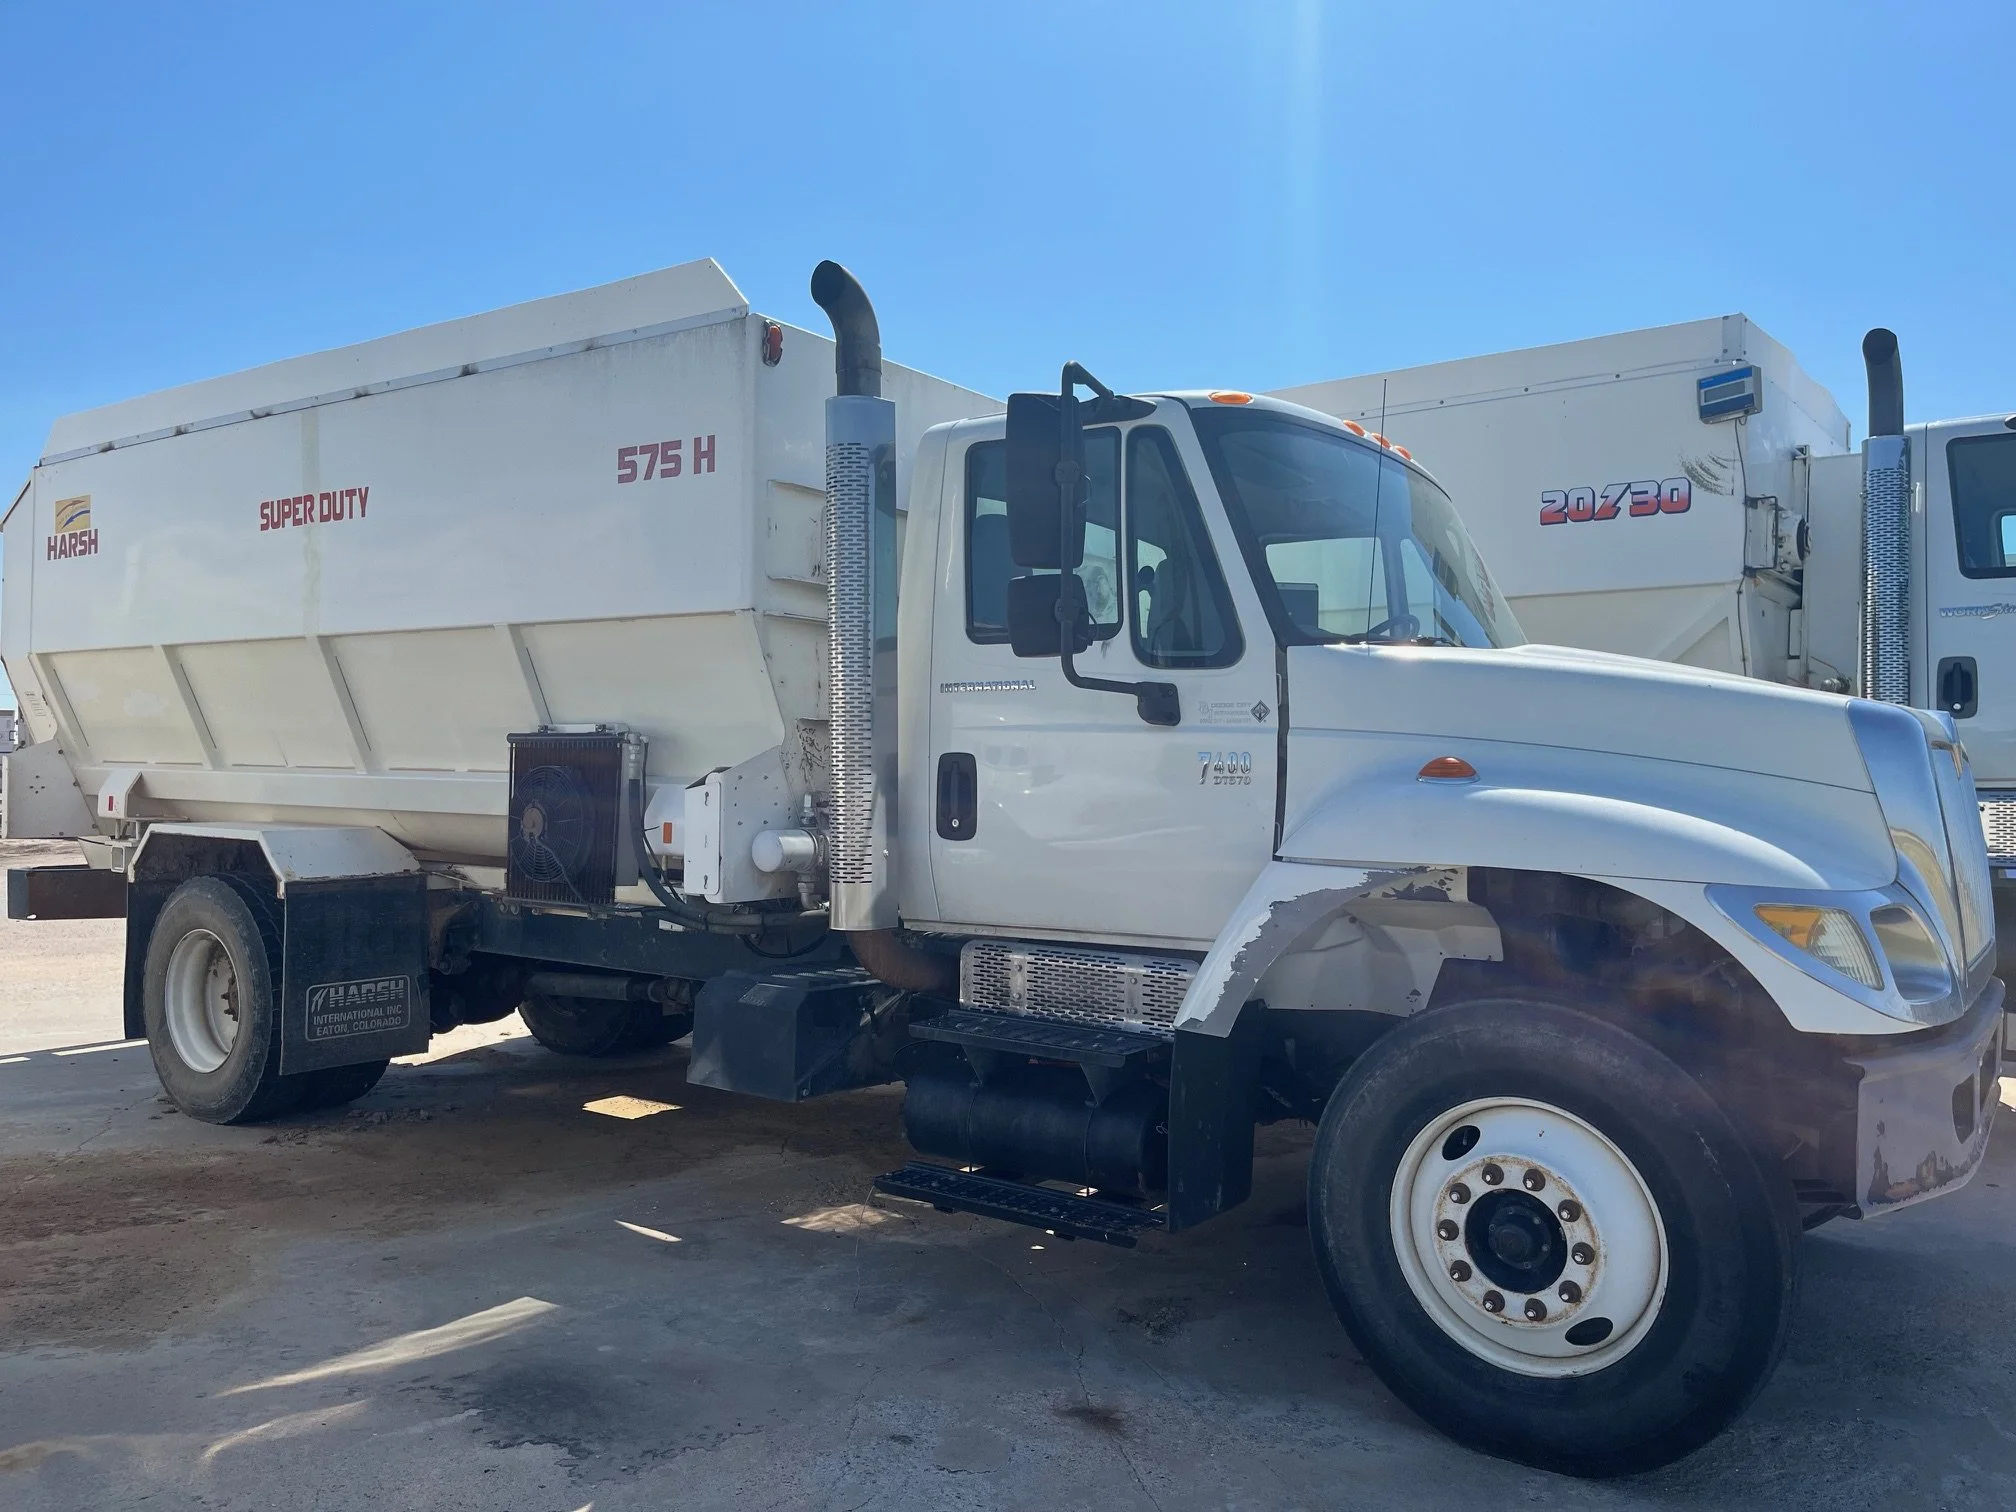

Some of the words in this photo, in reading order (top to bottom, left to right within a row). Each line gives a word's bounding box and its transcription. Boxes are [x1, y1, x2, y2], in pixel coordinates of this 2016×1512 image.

[618, 440, 682, 484] 575
[694, 435, 716, 474] H
[260, 494, 315, 532] SUPER
[319, 486, 370, 523] DUTY
[47, 528, 99, 561] HARSH
[940, 679, 1036, 693] INTERNATIONAL
[1198, 751, 1251, 785] 7400
[329, 979, 405, 1008] HARSH
[313, 1008, 384, 1025] INTERNATIONAL
[316, 1024, 350, 1036] EATON,
[352, 1016, 401, 1031] COLORADO
